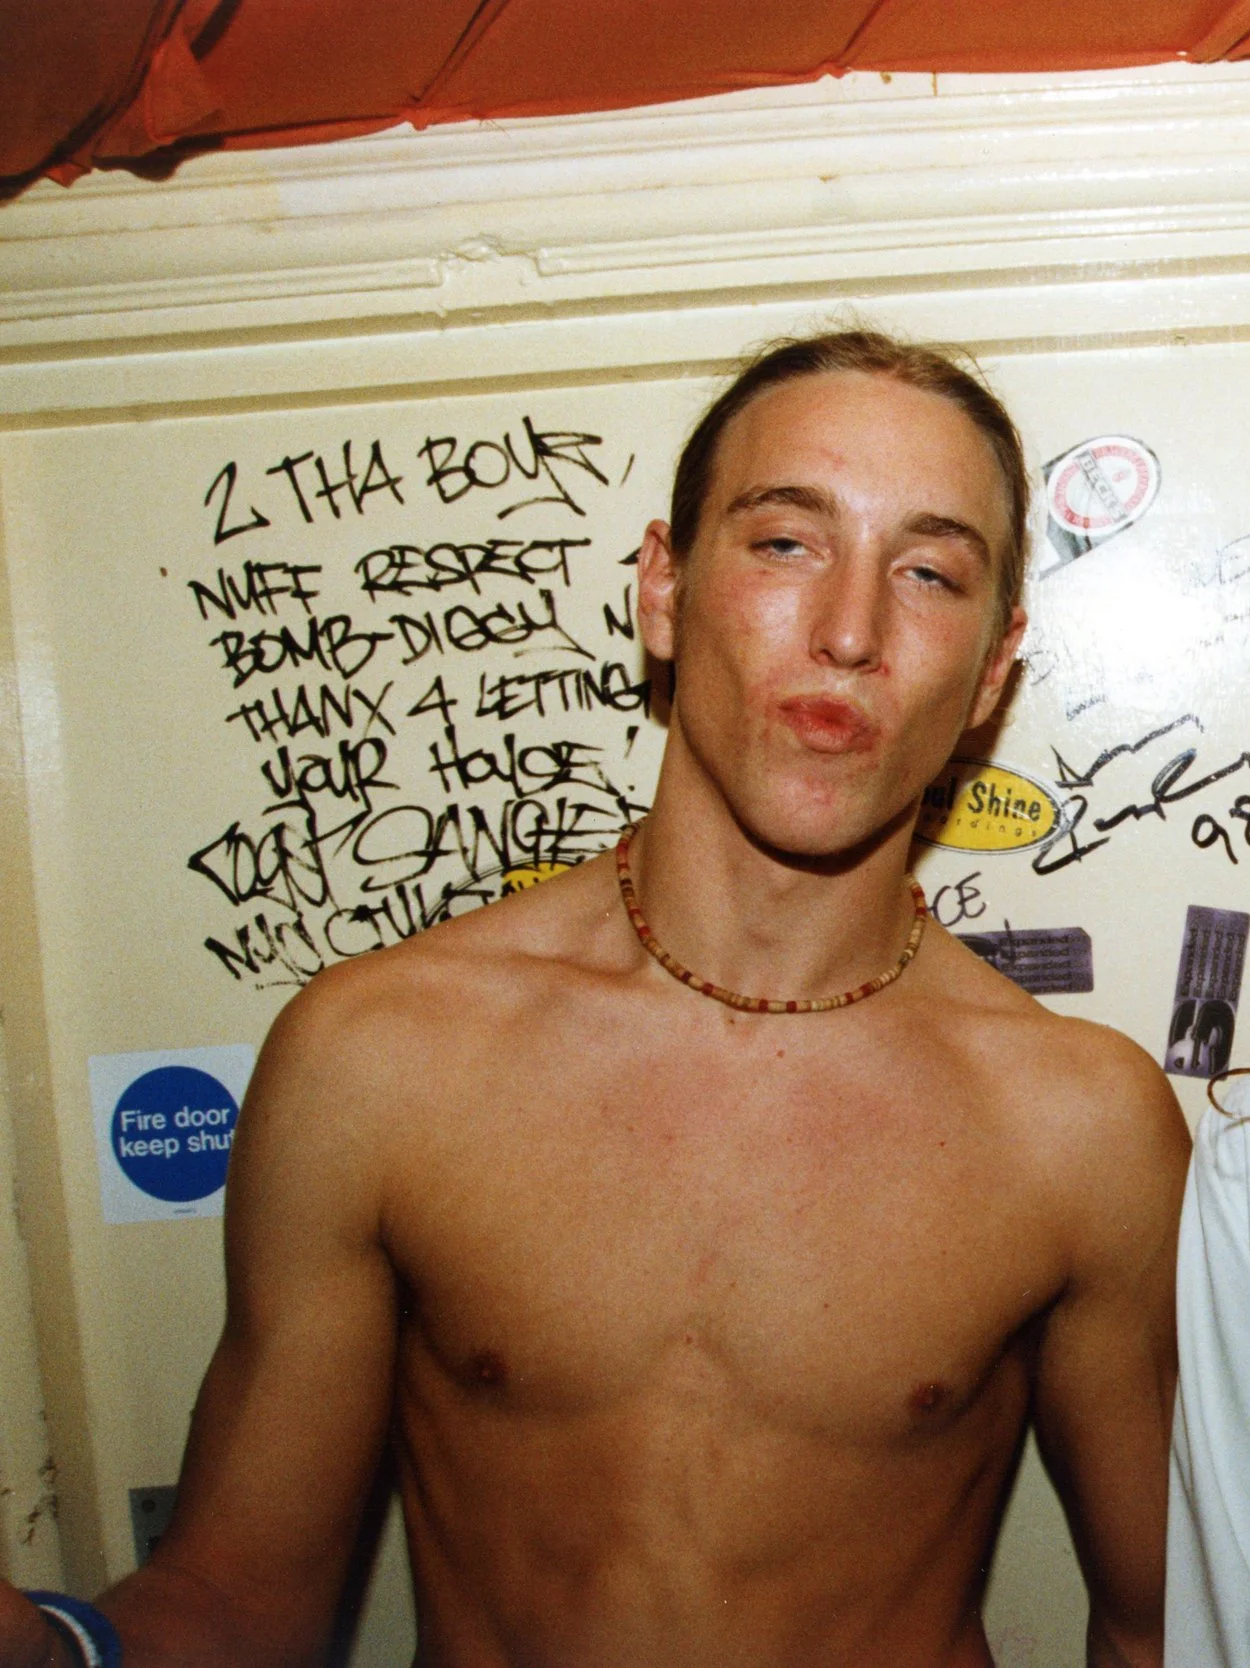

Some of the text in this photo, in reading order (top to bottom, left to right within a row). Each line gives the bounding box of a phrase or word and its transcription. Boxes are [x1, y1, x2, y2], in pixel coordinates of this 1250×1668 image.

[204, 461, 271, 545] 2
[266, 439, 404, 524] THA
[187, 537, 592, 621] NUFF RESPECT
[225, 660, 652, 743] THANX 4 LETTING
[966, 780, 1042, 824] Shine
[118, 1136, 180, 1160] keep
[119, 1105, 231, 1133] Fire door
